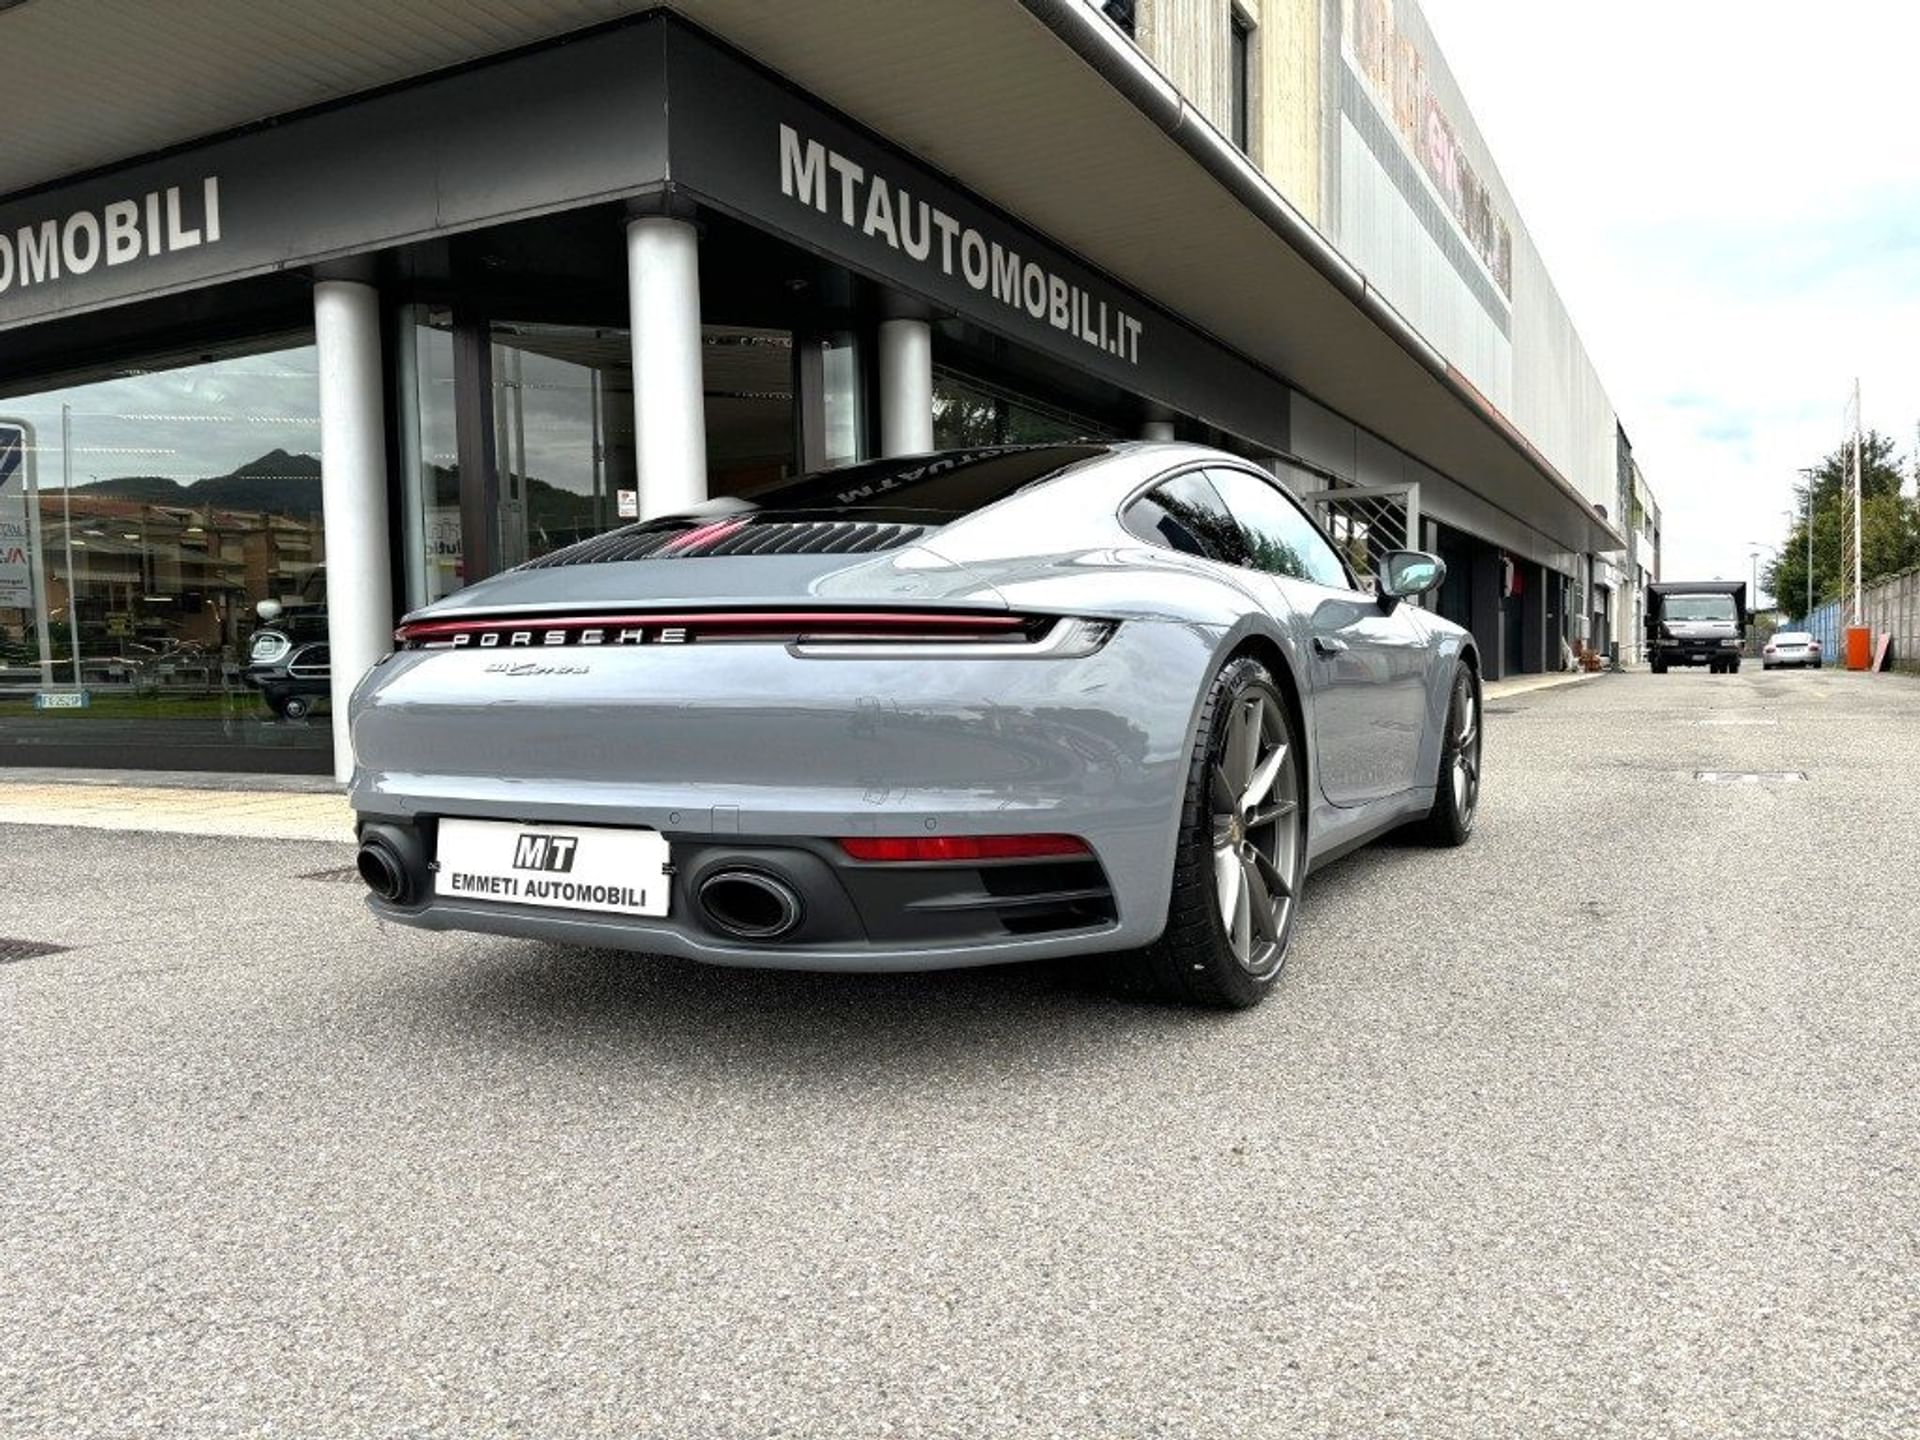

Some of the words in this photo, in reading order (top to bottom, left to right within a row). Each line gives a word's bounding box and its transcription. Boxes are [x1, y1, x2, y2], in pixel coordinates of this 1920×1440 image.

[779, 122, 1142, 364] MTAUTOMOBILI.IT
[453, 628, 686, 648] PORSCHE
[513, 833, 578, 873] MT
[452, 873, 518, 895] EMMETI
[525, 880, 647, 907] AUTOMOBILI
